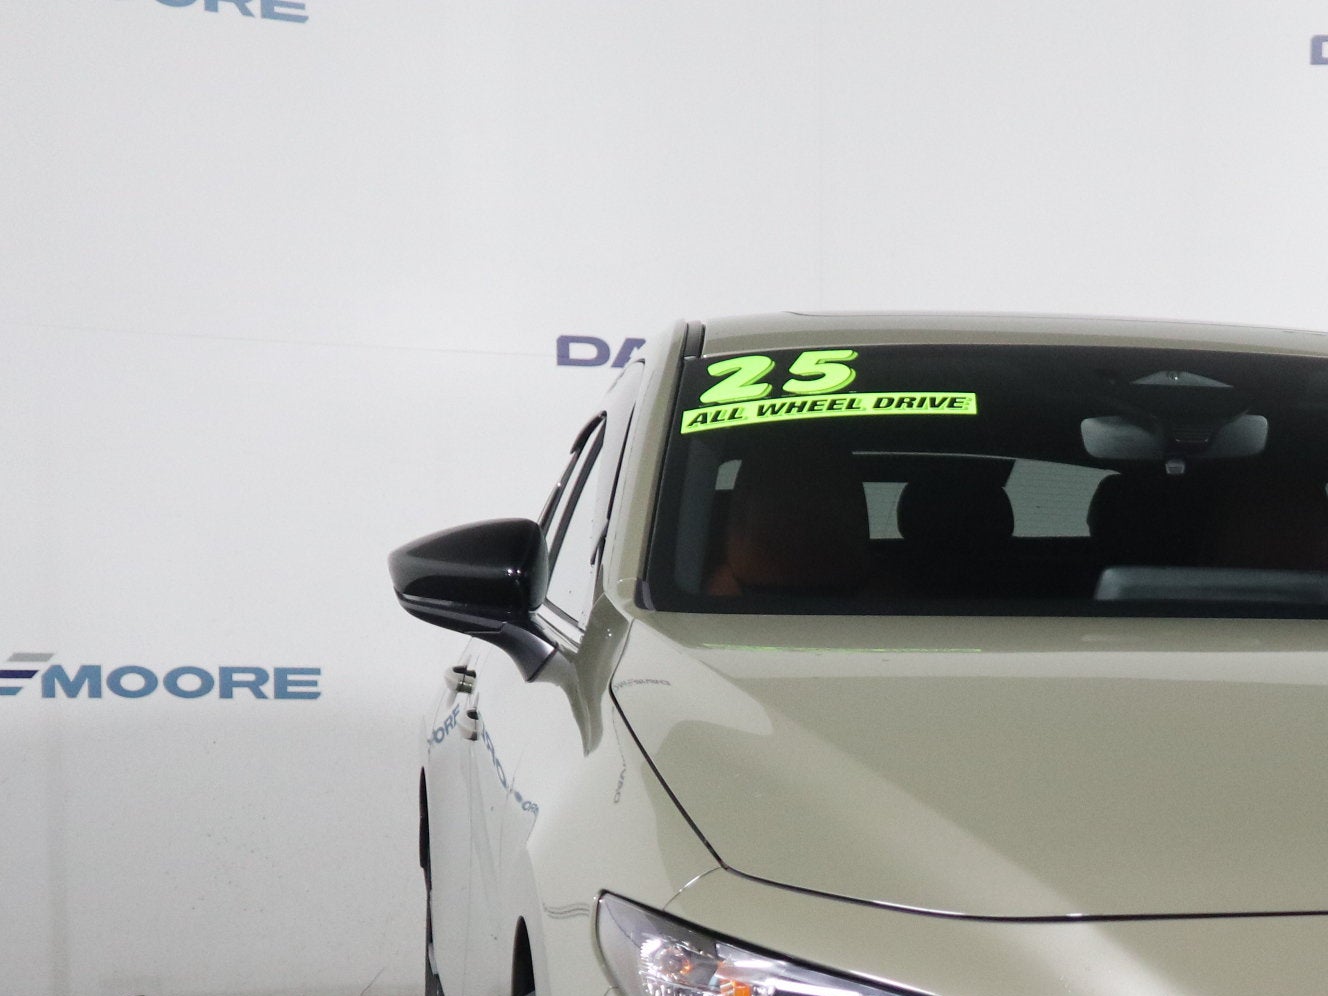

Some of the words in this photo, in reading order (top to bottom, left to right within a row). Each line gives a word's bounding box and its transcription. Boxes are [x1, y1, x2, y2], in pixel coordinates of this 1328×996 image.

[699, 349, 859, 405] 25
[687, 407, 744, 428] ALL
[756, 398, 860, 418] WHEEL
[872, 396, 969, 410] DRIVE
[41, 665, 321, 699] MOORE
